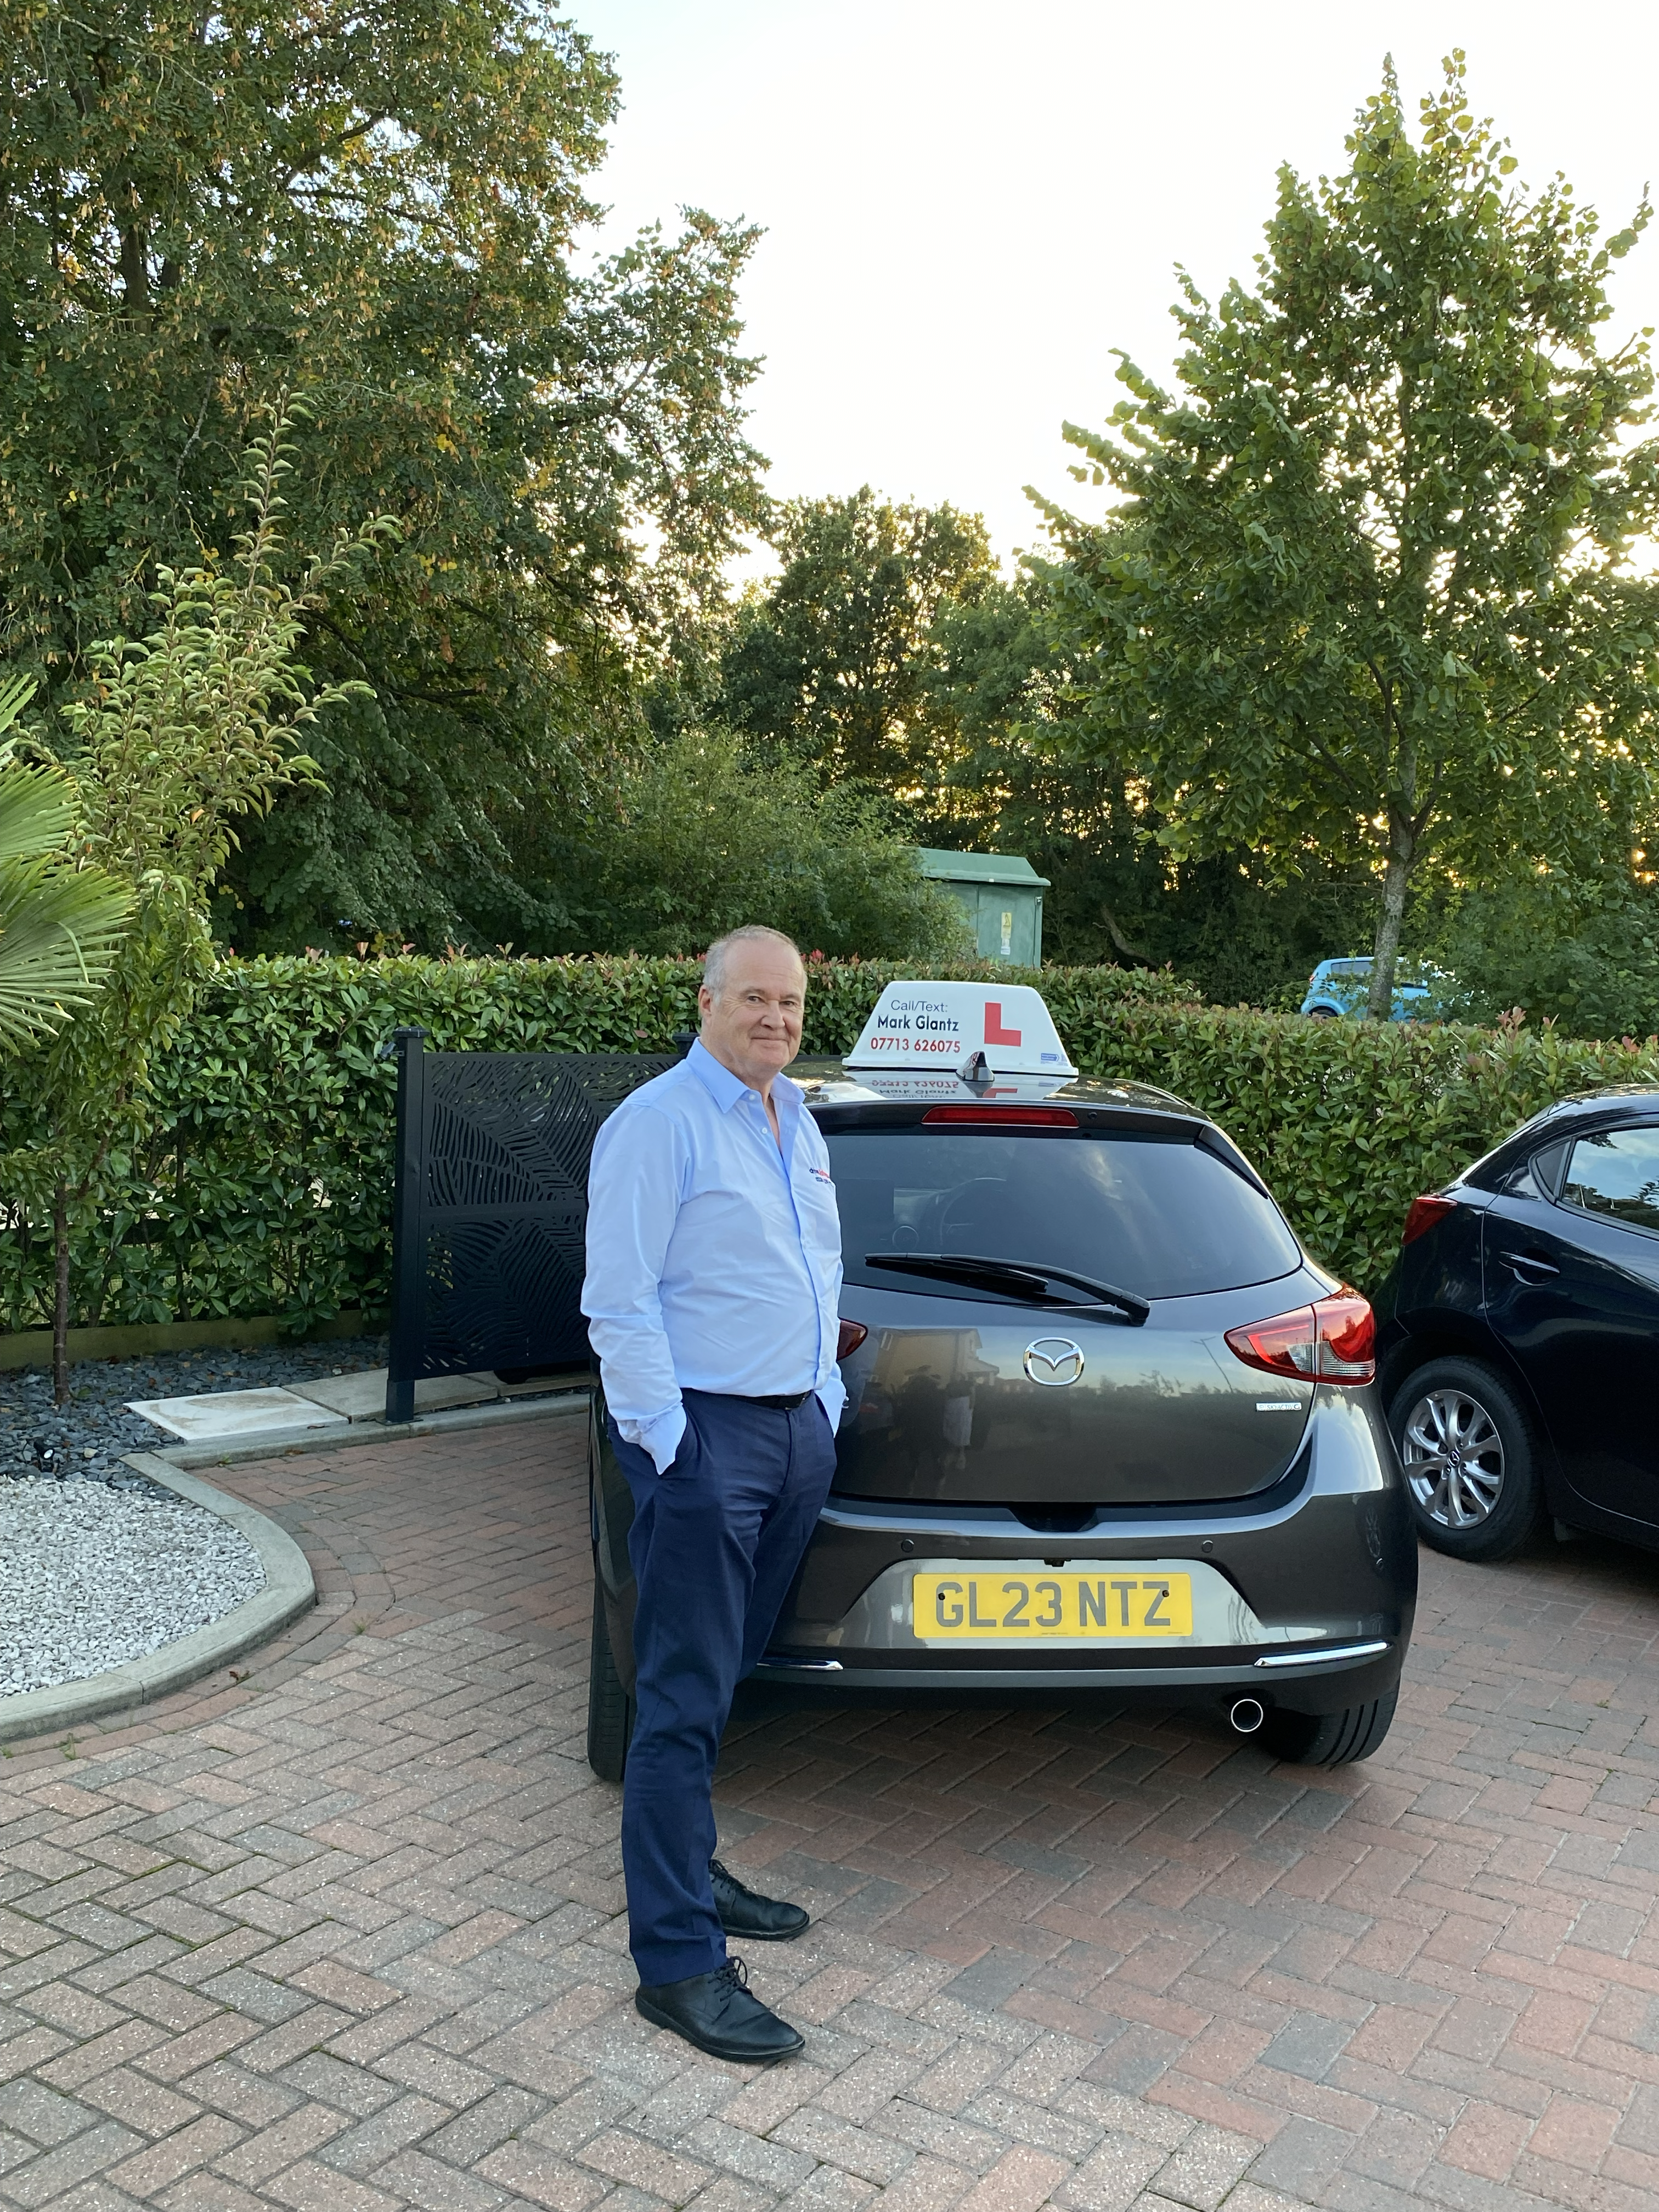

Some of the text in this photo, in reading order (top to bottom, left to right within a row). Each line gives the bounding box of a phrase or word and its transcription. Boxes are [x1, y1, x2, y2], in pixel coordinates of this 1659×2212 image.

[890, 1000, 948, 1013] Call/Text:
[878, 1014, 960, 1031] Mark Glantz
[984, 1002, 1022, 1047] L
[871, 1037, 961, 1053] 07713 626075
[936, 1581, 1171, 1628] GL23 NTZ
